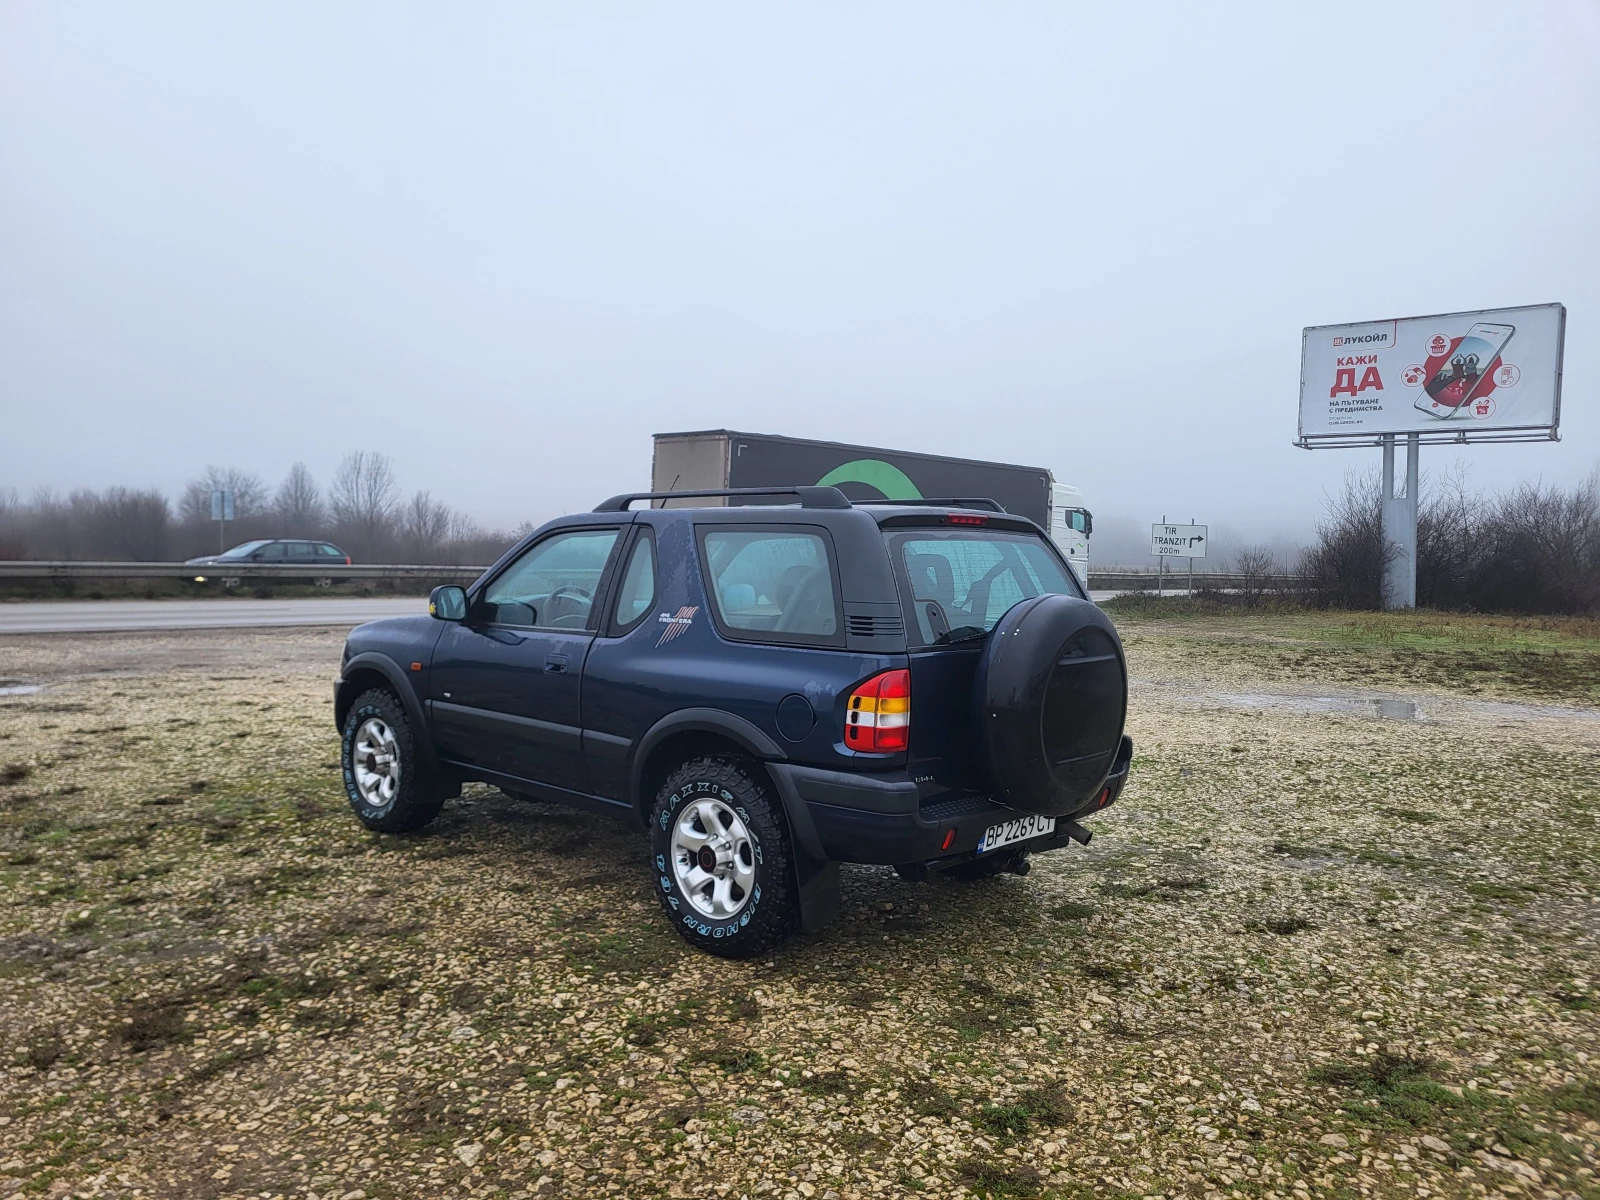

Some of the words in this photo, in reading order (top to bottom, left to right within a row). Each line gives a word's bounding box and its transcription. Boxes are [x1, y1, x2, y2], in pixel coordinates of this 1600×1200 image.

[1344, 333, 1387, 344] ЛУКОЙЛ
[1337, 355, 1377, 366] КАЖИ
[1330, 366, 1385, 398] ДА
[1341, 398, 1380, 406] ПЪТУВАНЕ
[1334, 406, 1383, 414] ПРЕДИМСТВА
[1154, 536, 1187, 546] TRANZIT
[659, 781, 734, 832] MAXXIS
[986, 825, 1004, 848] BP
[1004, 816, 1036, 842] 2269
[682, 883, 762, 938] BIGHORN
